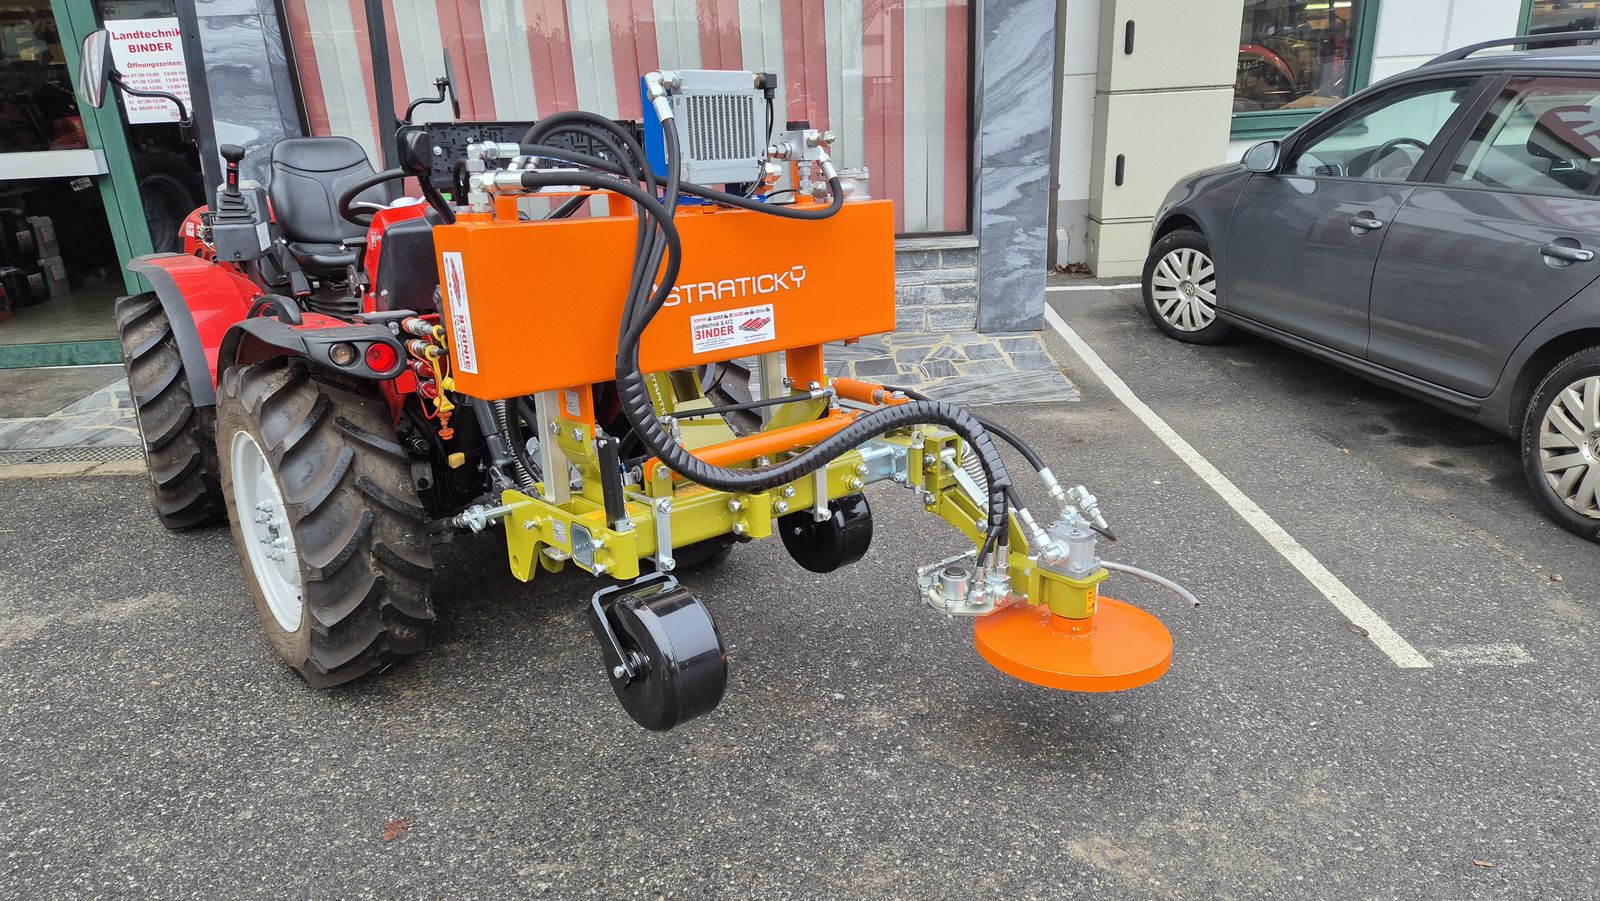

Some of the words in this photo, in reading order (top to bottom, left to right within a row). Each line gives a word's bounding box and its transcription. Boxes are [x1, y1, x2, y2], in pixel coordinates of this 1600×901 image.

[111, 28, 183, 41] Landtechnik
[128, 42, 173, 53] BINDER
[694, 325, 735, 340] BINDER
